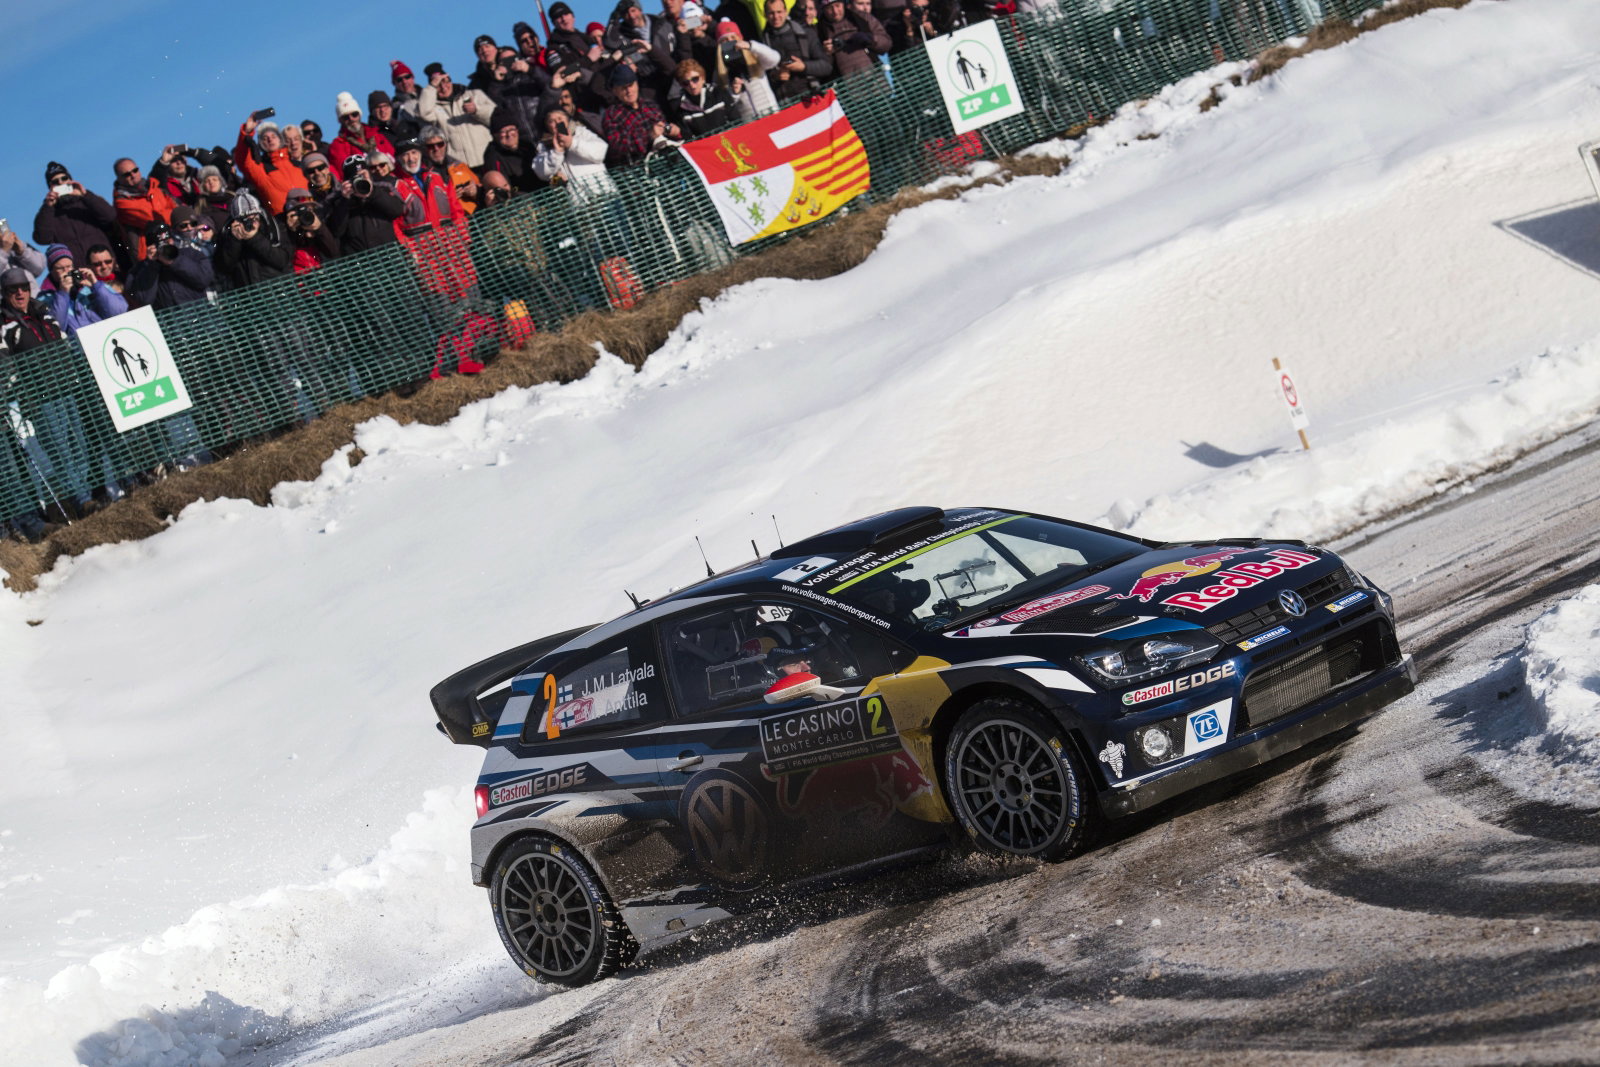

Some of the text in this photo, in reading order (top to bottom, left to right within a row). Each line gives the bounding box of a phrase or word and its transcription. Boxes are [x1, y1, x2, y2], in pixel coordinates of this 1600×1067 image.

[962, 91, 1000, 114] ZP 4
[738, 143, 752, 156] G
[121, 384, 165, 411] ZP 4
[862, 521, 981, 570] FIA World Rally Championship
[802, 551, 877, 587] Volkswagen
[781, 584, 891, 629] www.volkswagen-motorsport.com
[1339, 591, 1364, 606] MICHELIN
[1254, 627, 1286, 643] MICHELIN
[611, 662, 655, 687] Latvala
[1134, 662, 1237, 703] Castrol EDGE
[544, 673, 561, 740] 2
[605, 690, 649, 717] Anttila
[866, 696, 888, 736] 2
[472, 723, 489, 735] OMP
[764, 707, 855, 742] LE CASINO
[500, 764, 588, 802] Castrol EDGE
[1062, 757, 1079, 818] MICHELIN
[565, 855, 599, 899] MICHELIN
